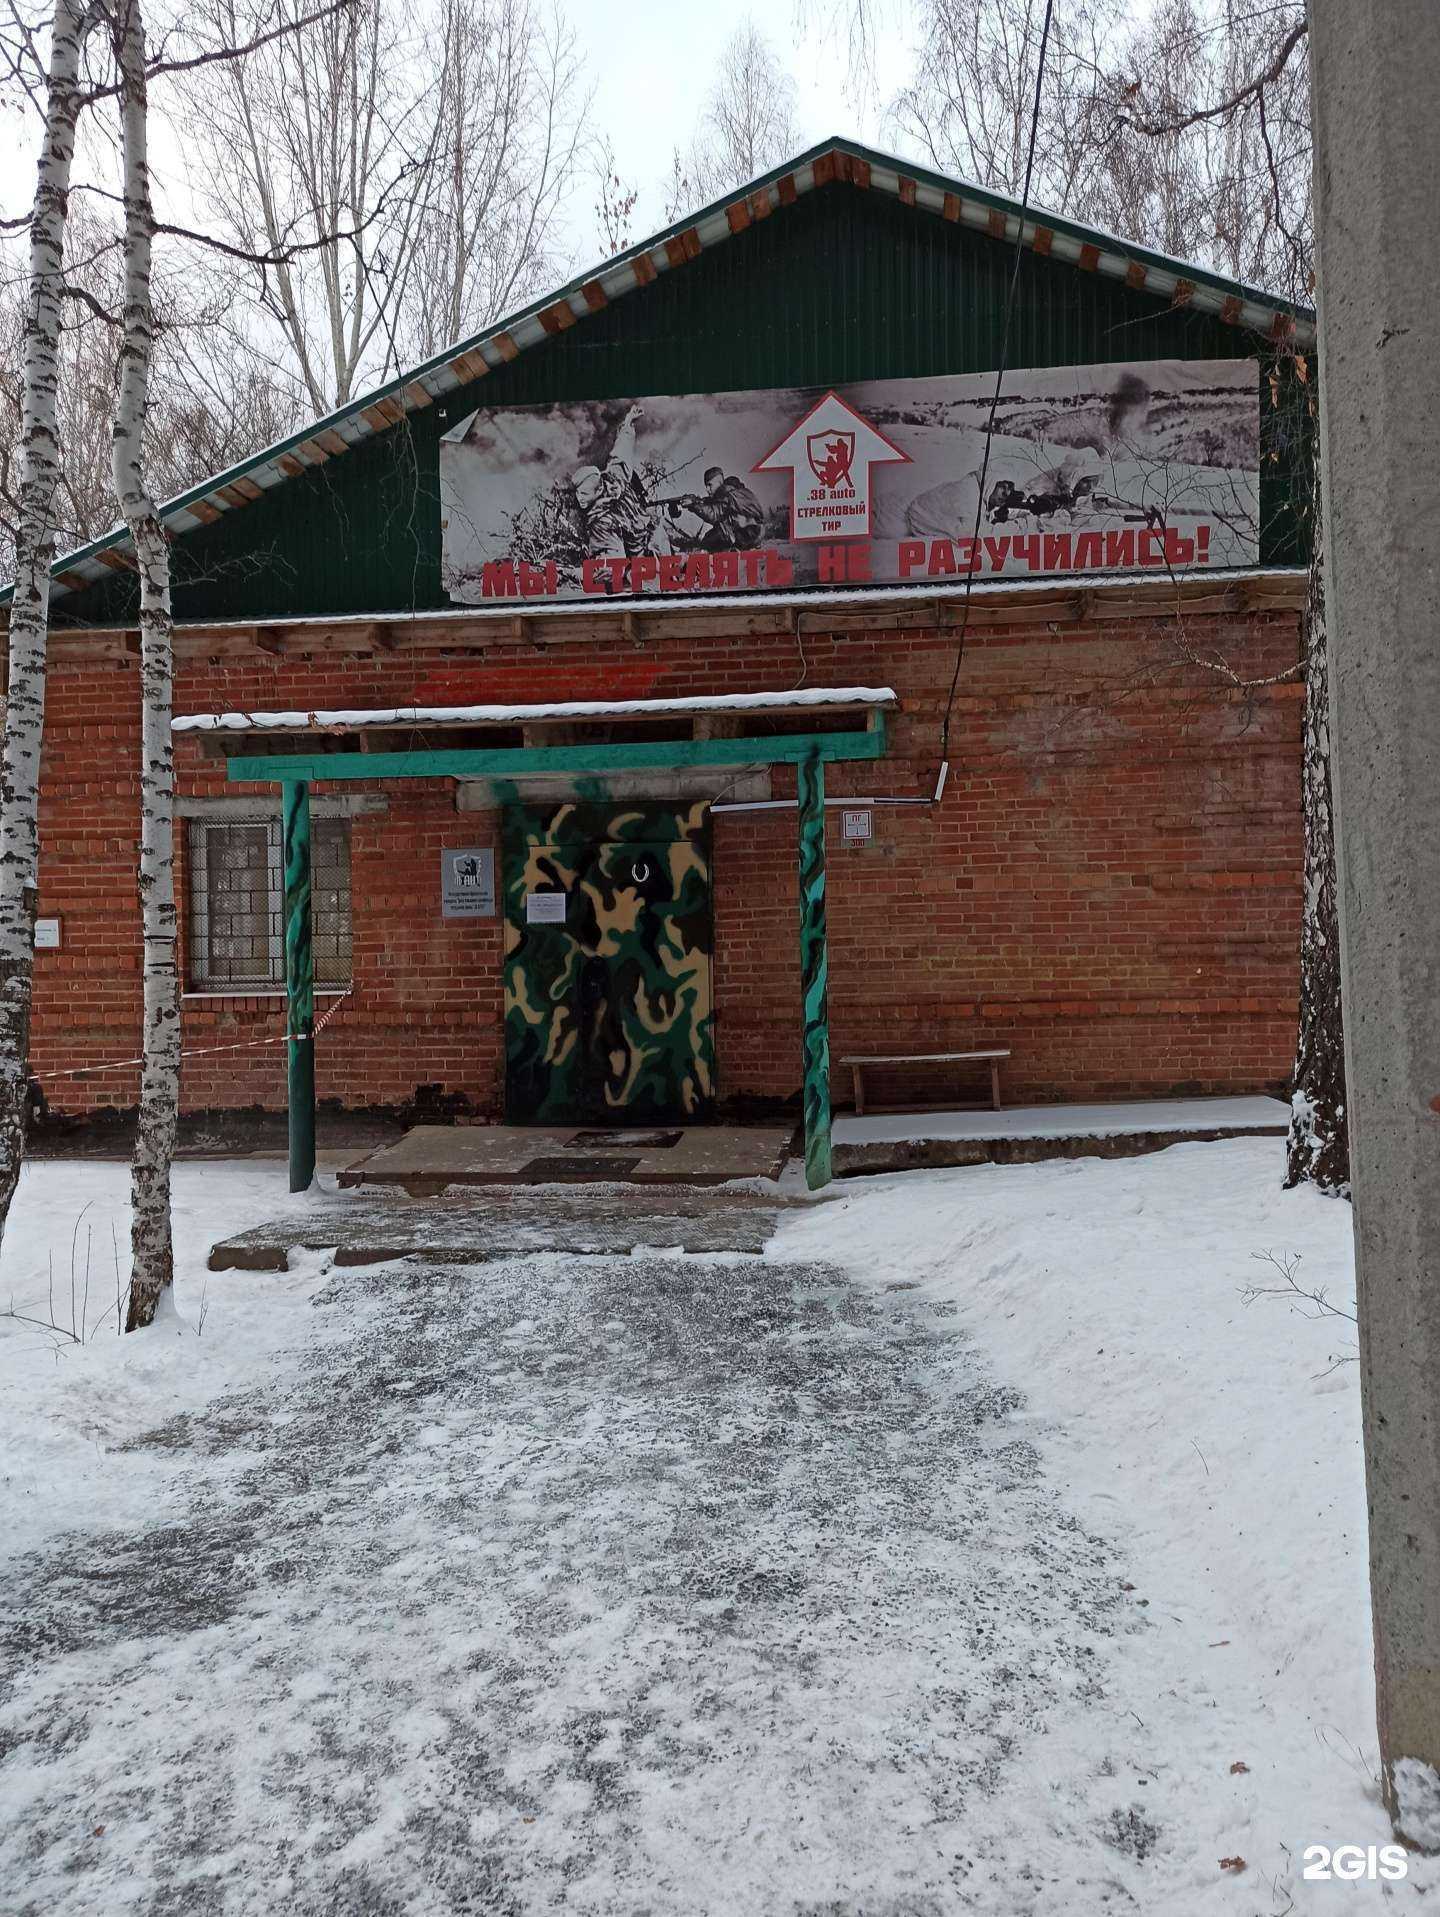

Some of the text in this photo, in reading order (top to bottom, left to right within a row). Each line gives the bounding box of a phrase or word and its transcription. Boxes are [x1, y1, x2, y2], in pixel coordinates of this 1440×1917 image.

[807, 487, 856, 500] .38 auto
[797, 501, 866, 518] СТРЕЛКОВЫЙ
[821, 521, 842, 532] ТИР
[582, 549, 793, 594] СТРЕЛЯТЬ
[818, 544, 873, 583] НЕ
[898, 525, 1211, 577] РАЗУЧИЛИСЬ!
